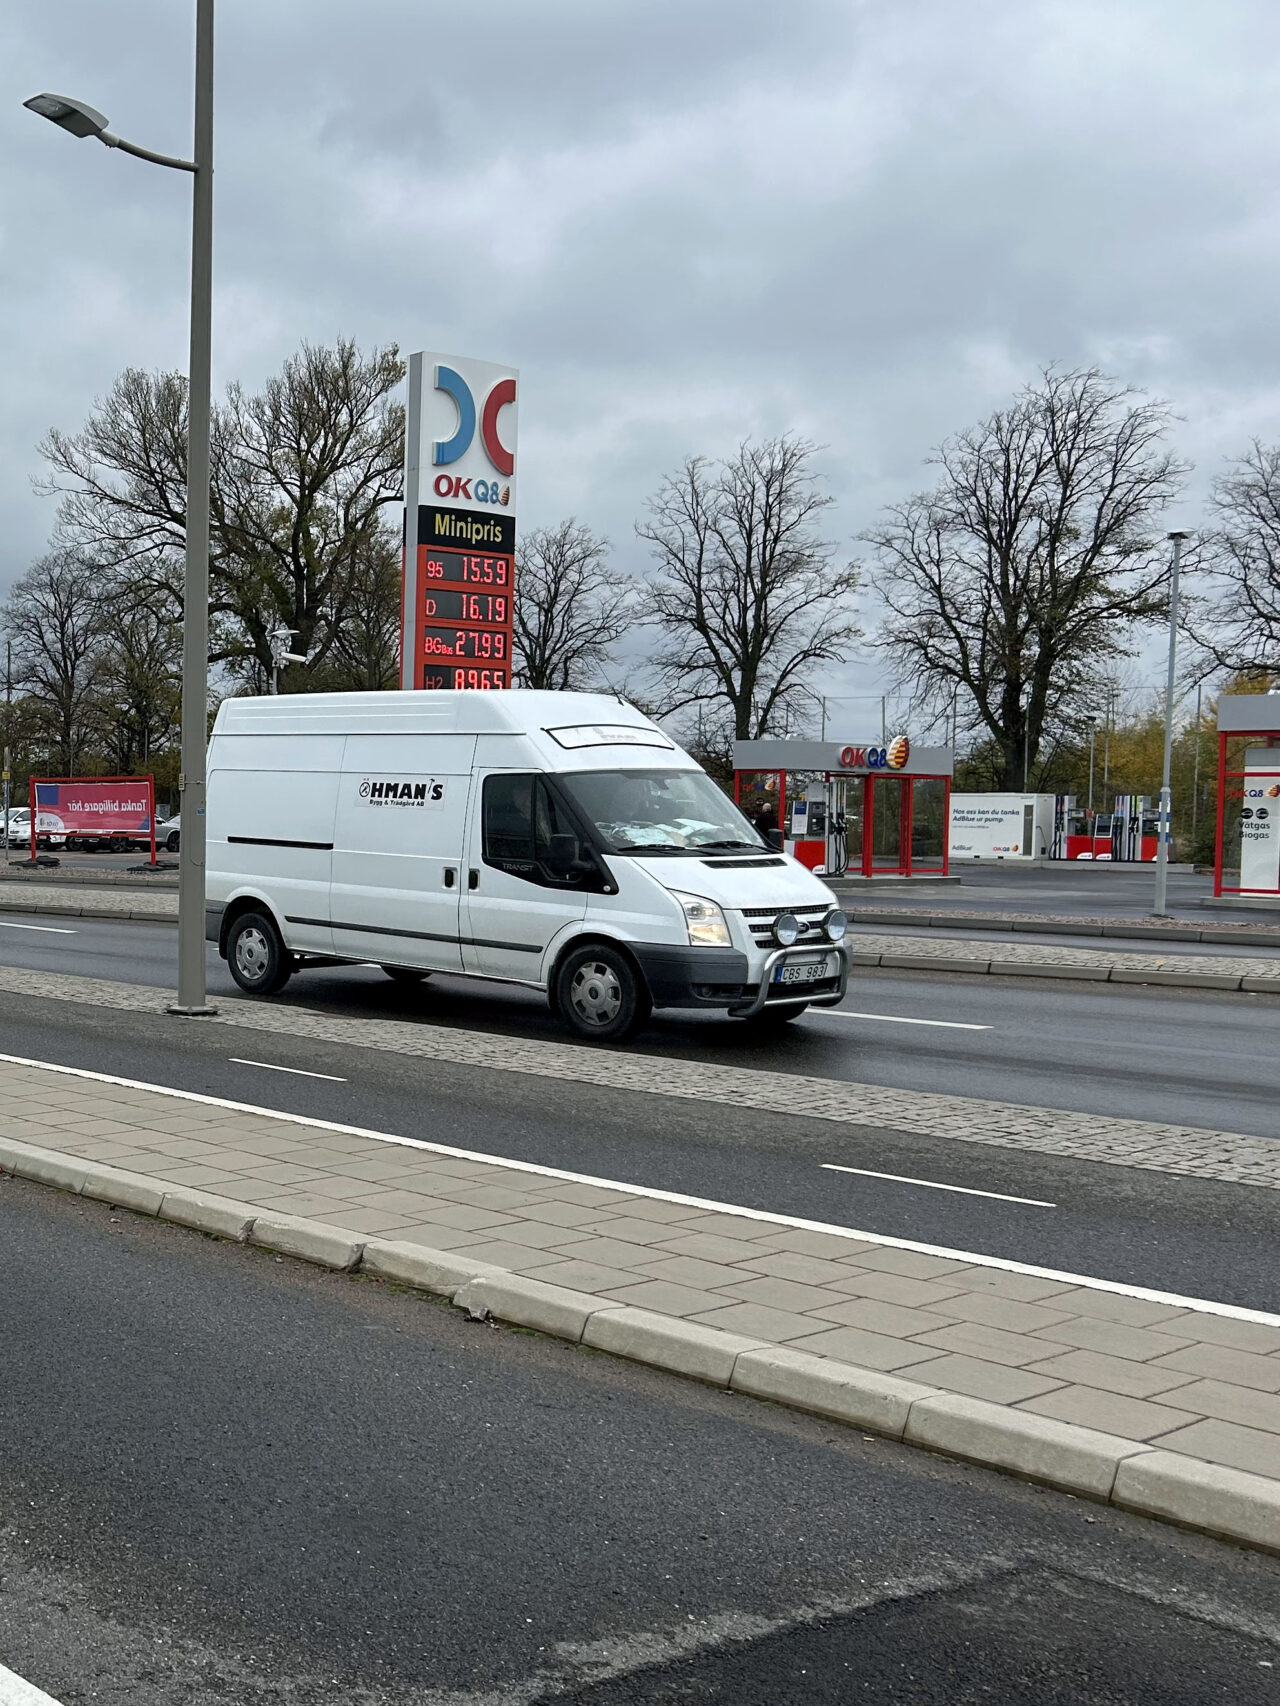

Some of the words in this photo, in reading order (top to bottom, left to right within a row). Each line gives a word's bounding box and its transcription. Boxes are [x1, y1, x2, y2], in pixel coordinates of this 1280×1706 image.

[435, 513, 503, 544] Minipris
[427, 560, 443, 577] 95
[463, 557, 506, 584] 15.59
[426, 599, 436, 615] D
[462, 594, 505, 621] 16.19
[456, 631, 504, 658] 27.99
[841, 746, 886, 768] OKQ8
[1239, 831, 1269, 840] Biogas
[783, 968, 801, 980] CBS
[806, 966, 824, 978] 983
